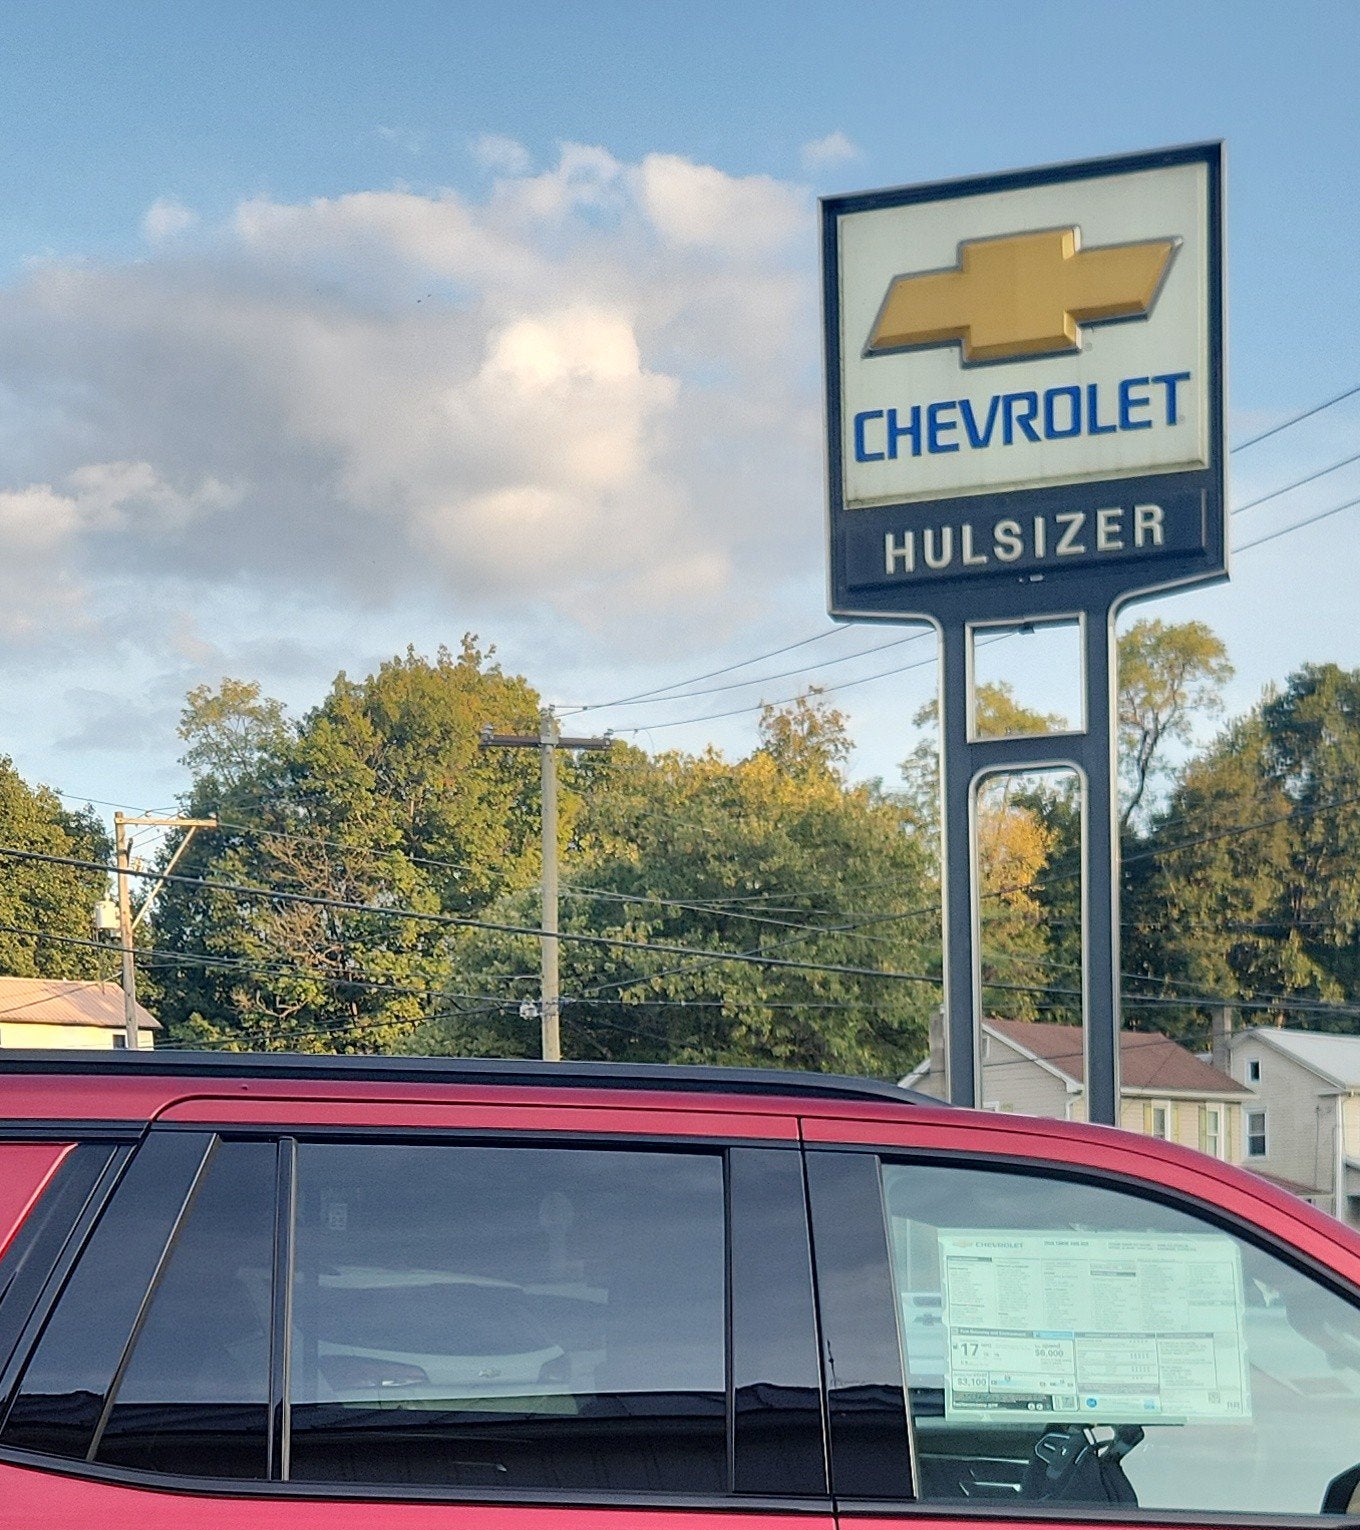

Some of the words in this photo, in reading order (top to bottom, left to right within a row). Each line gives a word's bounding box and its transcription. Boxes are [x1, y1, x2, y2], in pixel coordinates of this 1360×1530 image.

[853, 371, 1191, 464] CHEVROLET
[884, 503, 1166, 576] HULSIZER
[960, 1342, 979, 1357] 17
